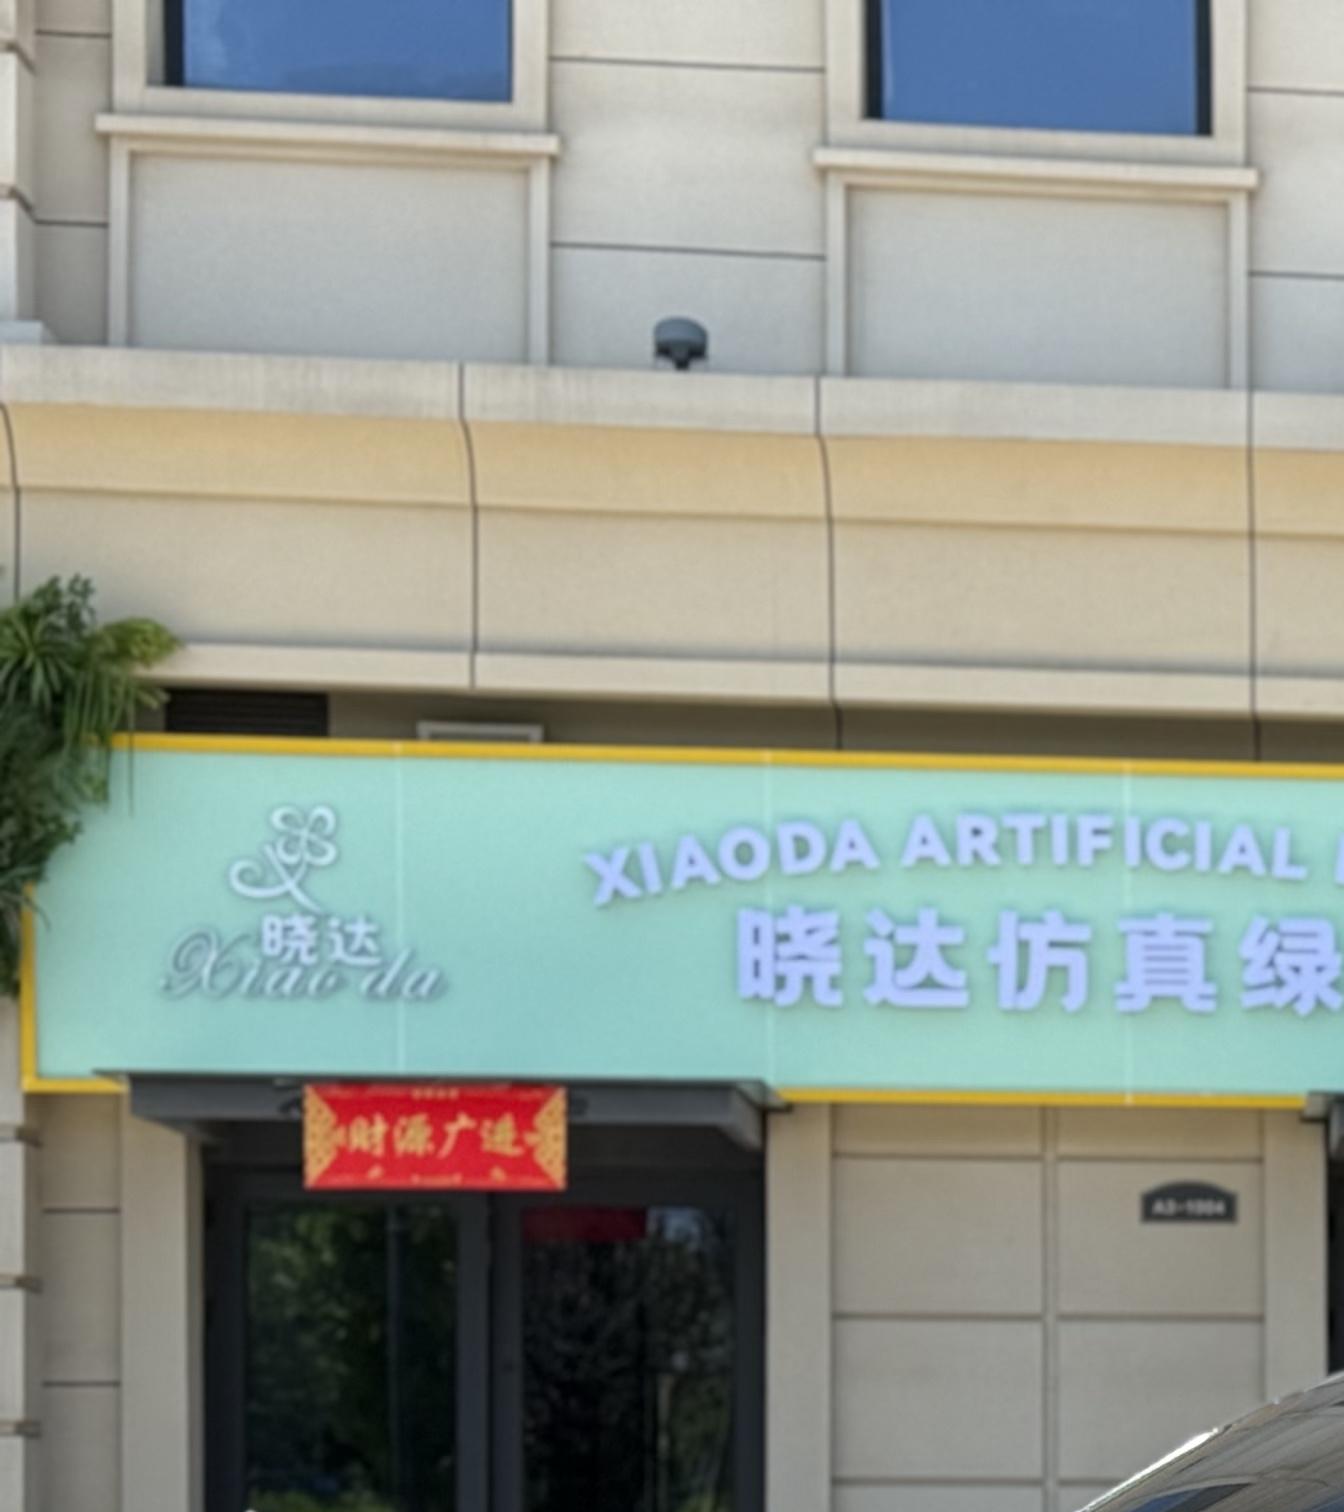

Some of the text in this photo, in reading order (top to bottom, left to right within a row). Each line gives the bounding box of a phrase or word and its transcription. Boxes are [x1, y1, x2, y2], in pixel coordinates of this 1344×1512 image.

[583, 818, 880, 906] XIAODA
[902, 812, 1308, 880] ARTIFICIAL
[262, 913, 382, 966] 晓达
[350, 1111, 525, 1158] 财源广进
